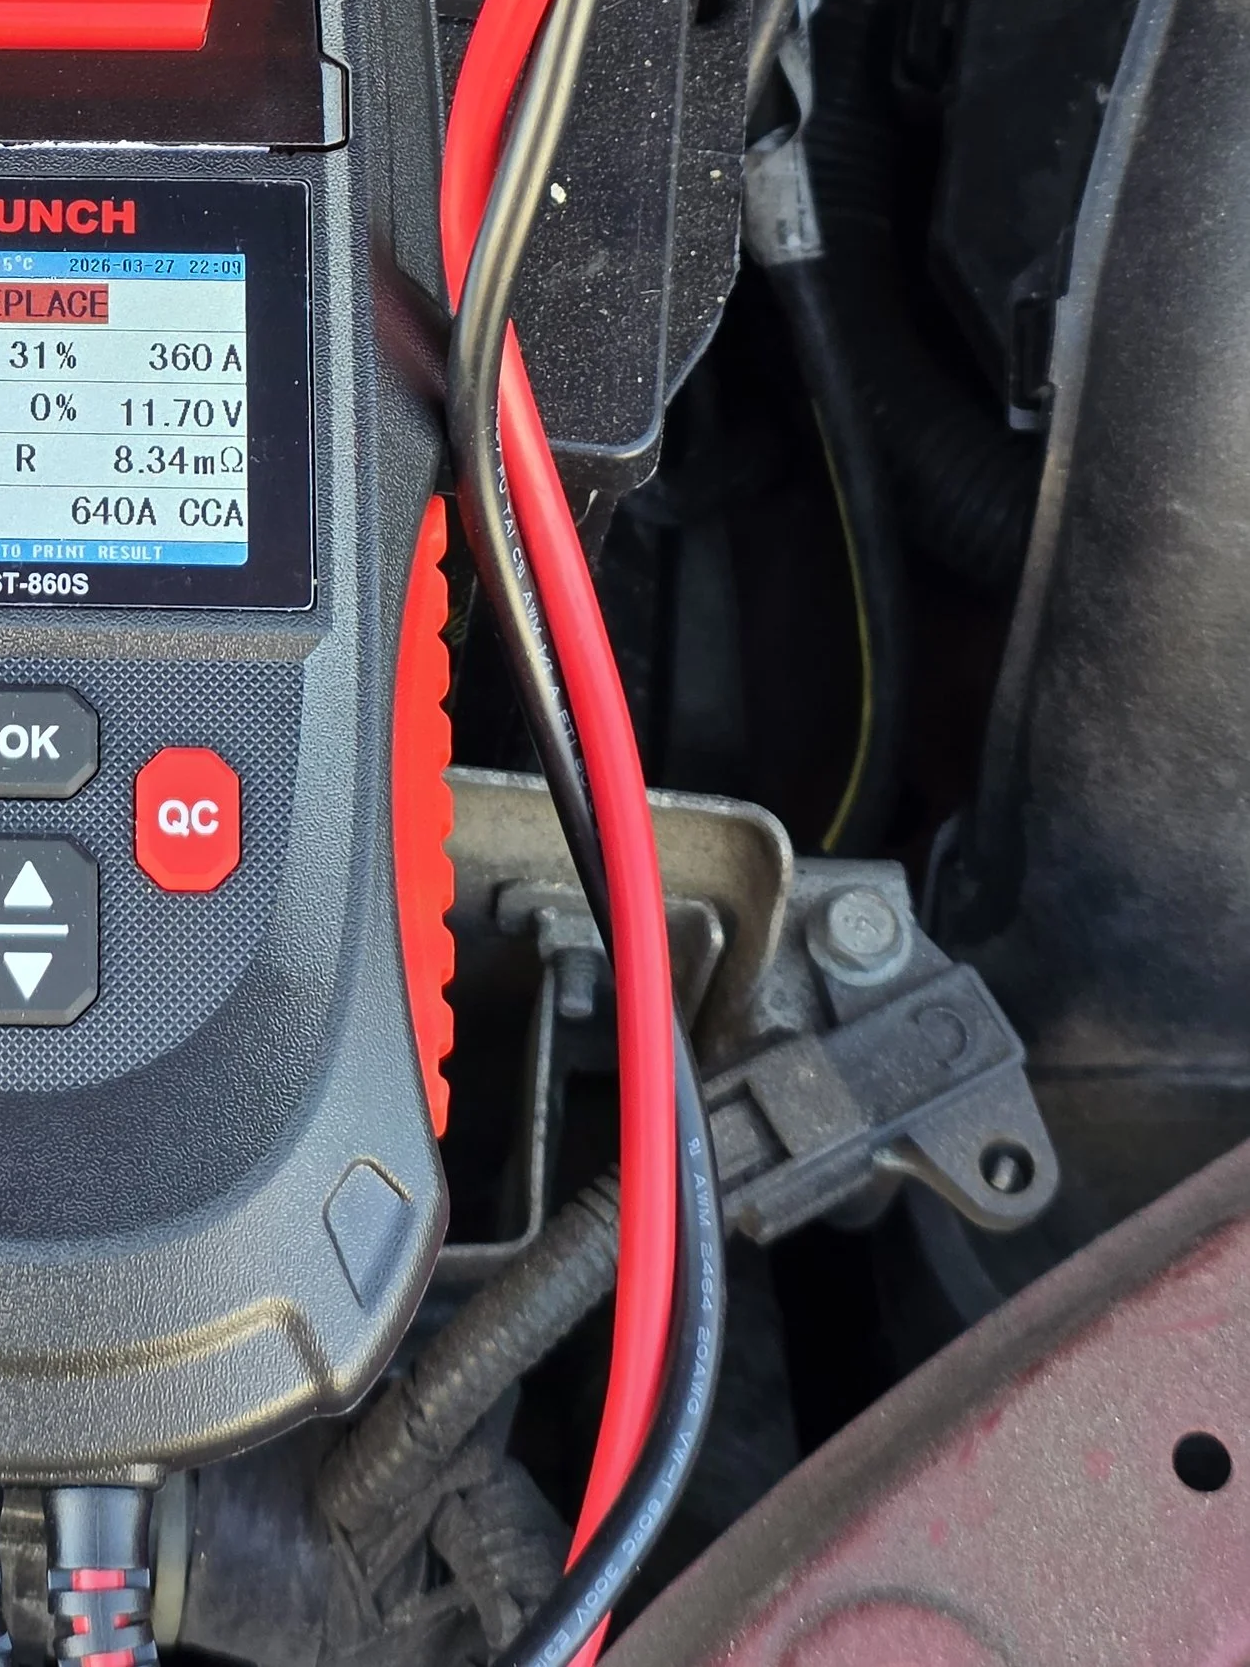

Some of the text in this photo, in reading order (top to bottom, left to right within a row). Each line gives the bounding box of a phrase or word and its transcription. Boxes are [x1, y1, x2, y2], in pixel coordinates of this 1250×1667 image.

[69, 257, 175, 274] 2026-03-27
[189, 259, 242, 275] 22:09
[9, 341, 77, 371] 31%
[30, 393, 77, 421] 0%
[16, 444, 36, 472] R
[71, 497, 156, 526] 640A
[178, 498, 243, 527] CCA
[0, 543, 21, 559] TO
[33, 544, 87, 560] PRINT
[98, 545, 163, 560] RESULT
[523, 591, 542, 635] AWM
[549, 685, 560, 702] A
[158, 799, 220, 838] QC
[694, 1172, 711, 1226] AWM
[700, 1242, 713, 1312] 2464
[687, 1325, 710, 1415] 20AWG
[575, 1561, 619, 1624] 300V
